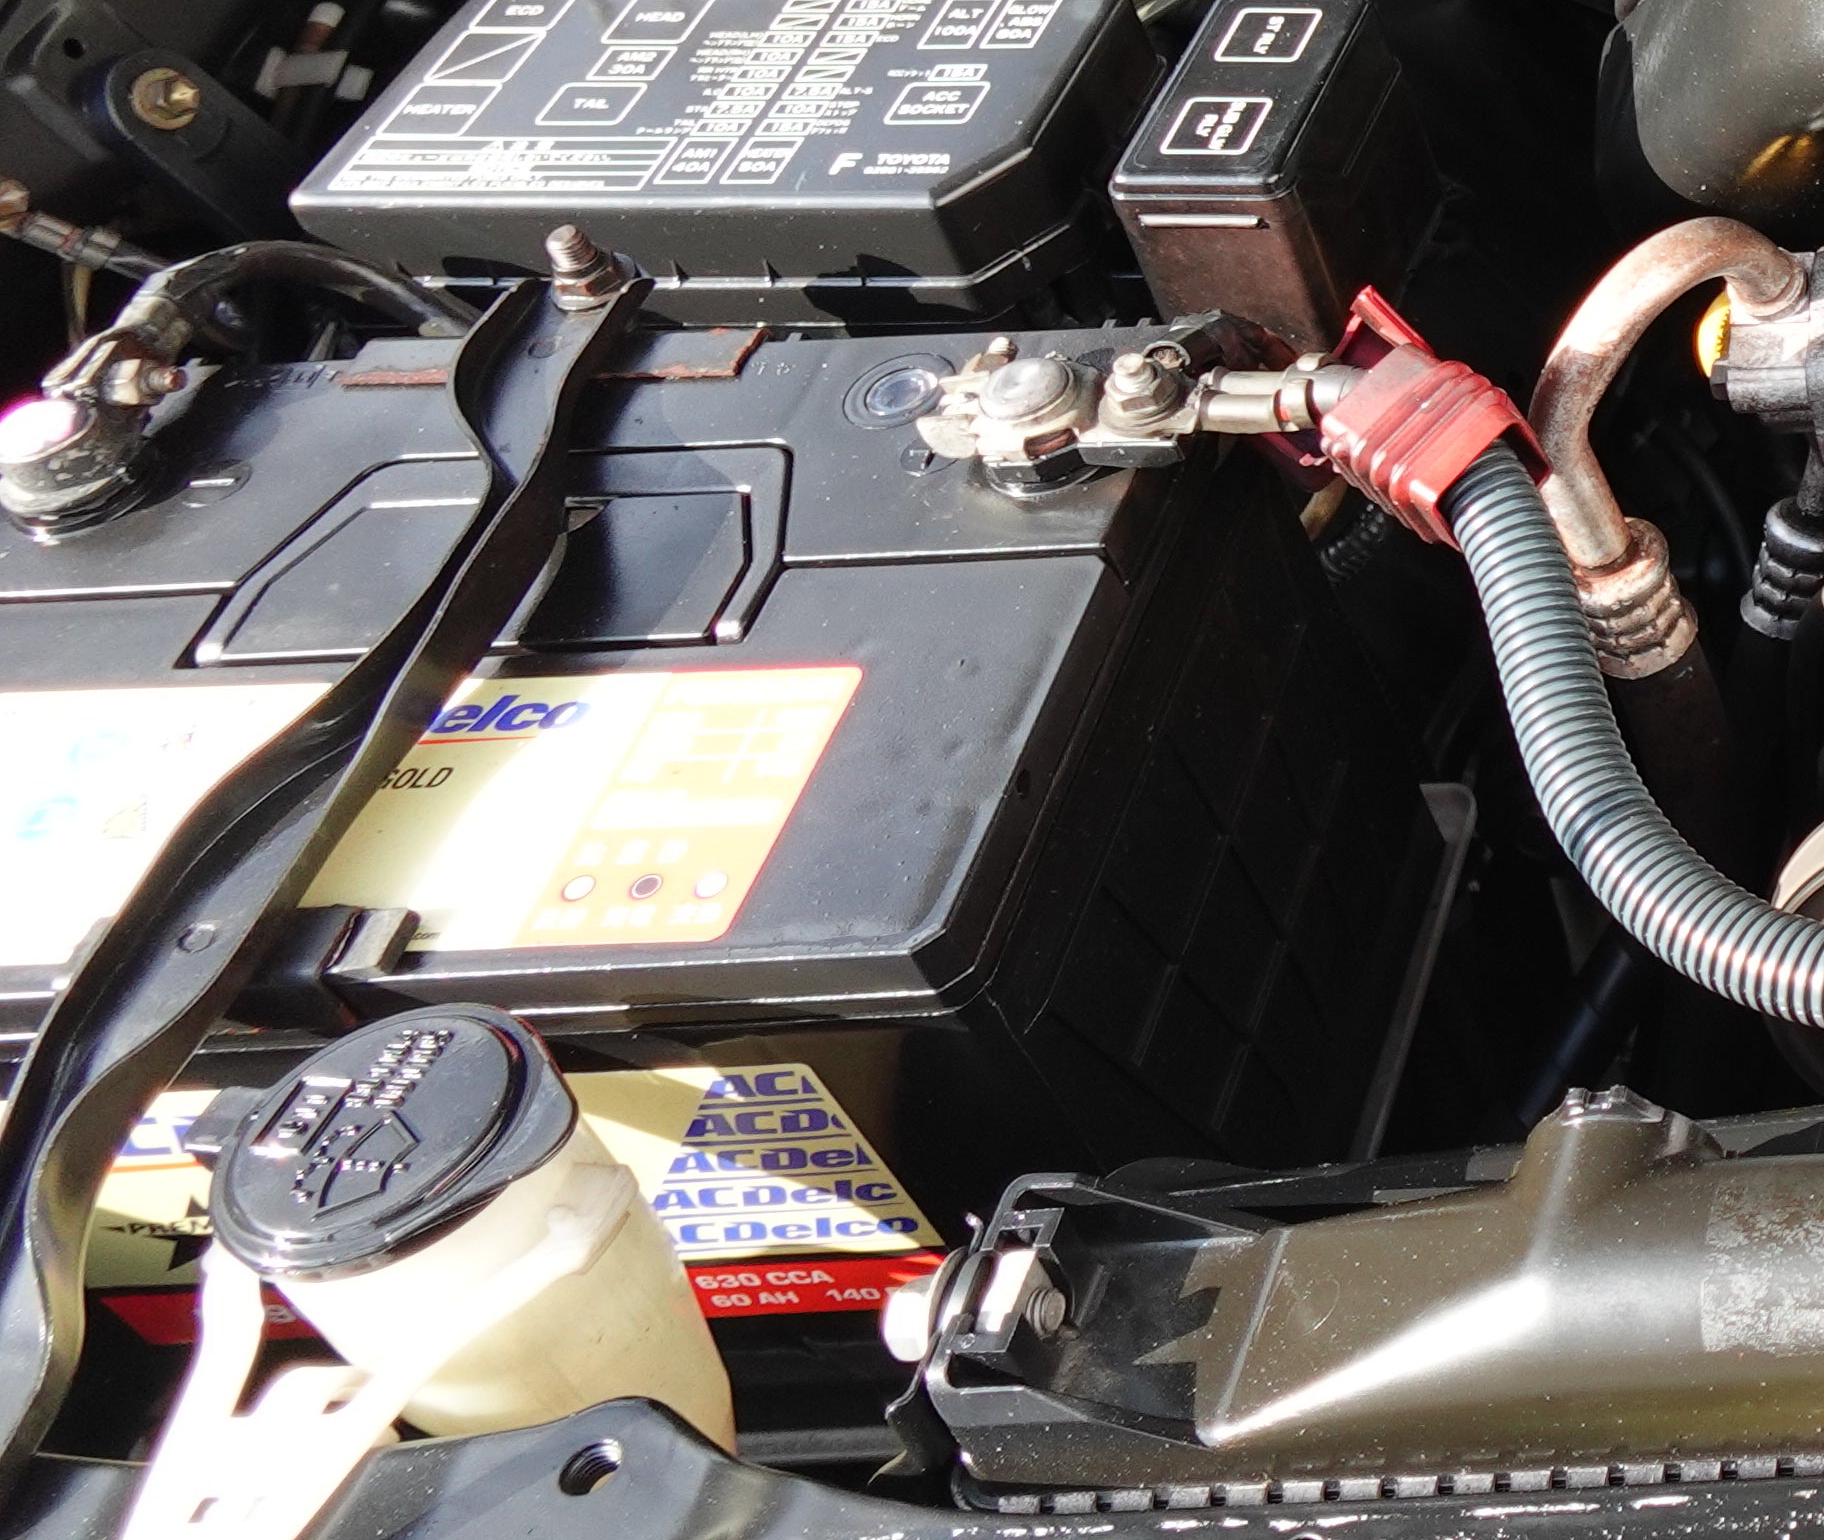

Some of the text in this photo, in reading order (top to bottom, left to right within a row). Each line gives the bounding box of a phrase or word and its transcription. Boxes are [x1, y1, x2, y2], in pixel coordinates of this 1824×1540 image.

[634, 11, 686, 23] HEAD
[948, 8, 985, 19] ALT
[772, 34, 804, 44] 10A
[760, 51, 791, 62] 10A
[747, 69, 778, 79] 10A
[922, 91, 961, 101] ACC
[403, 104, 477, 116] HEATER
[785, 104, 817, 115] 10A
[897, 104, 970, 115] SOCKET
[706, 121, 738, 133] 10A
[877, 152, 951, 166] TOYOTA
[671, 161, 711, 173] 40A
[429, 695, 592, 734] elco
[704, 1071, 819, 1100] AC
[670, 1216, 920, 1245] CDelco
[694, 1269, 835, 1290] 630 CCA
[710, 1286, 881, 1308] 60 AH 140
